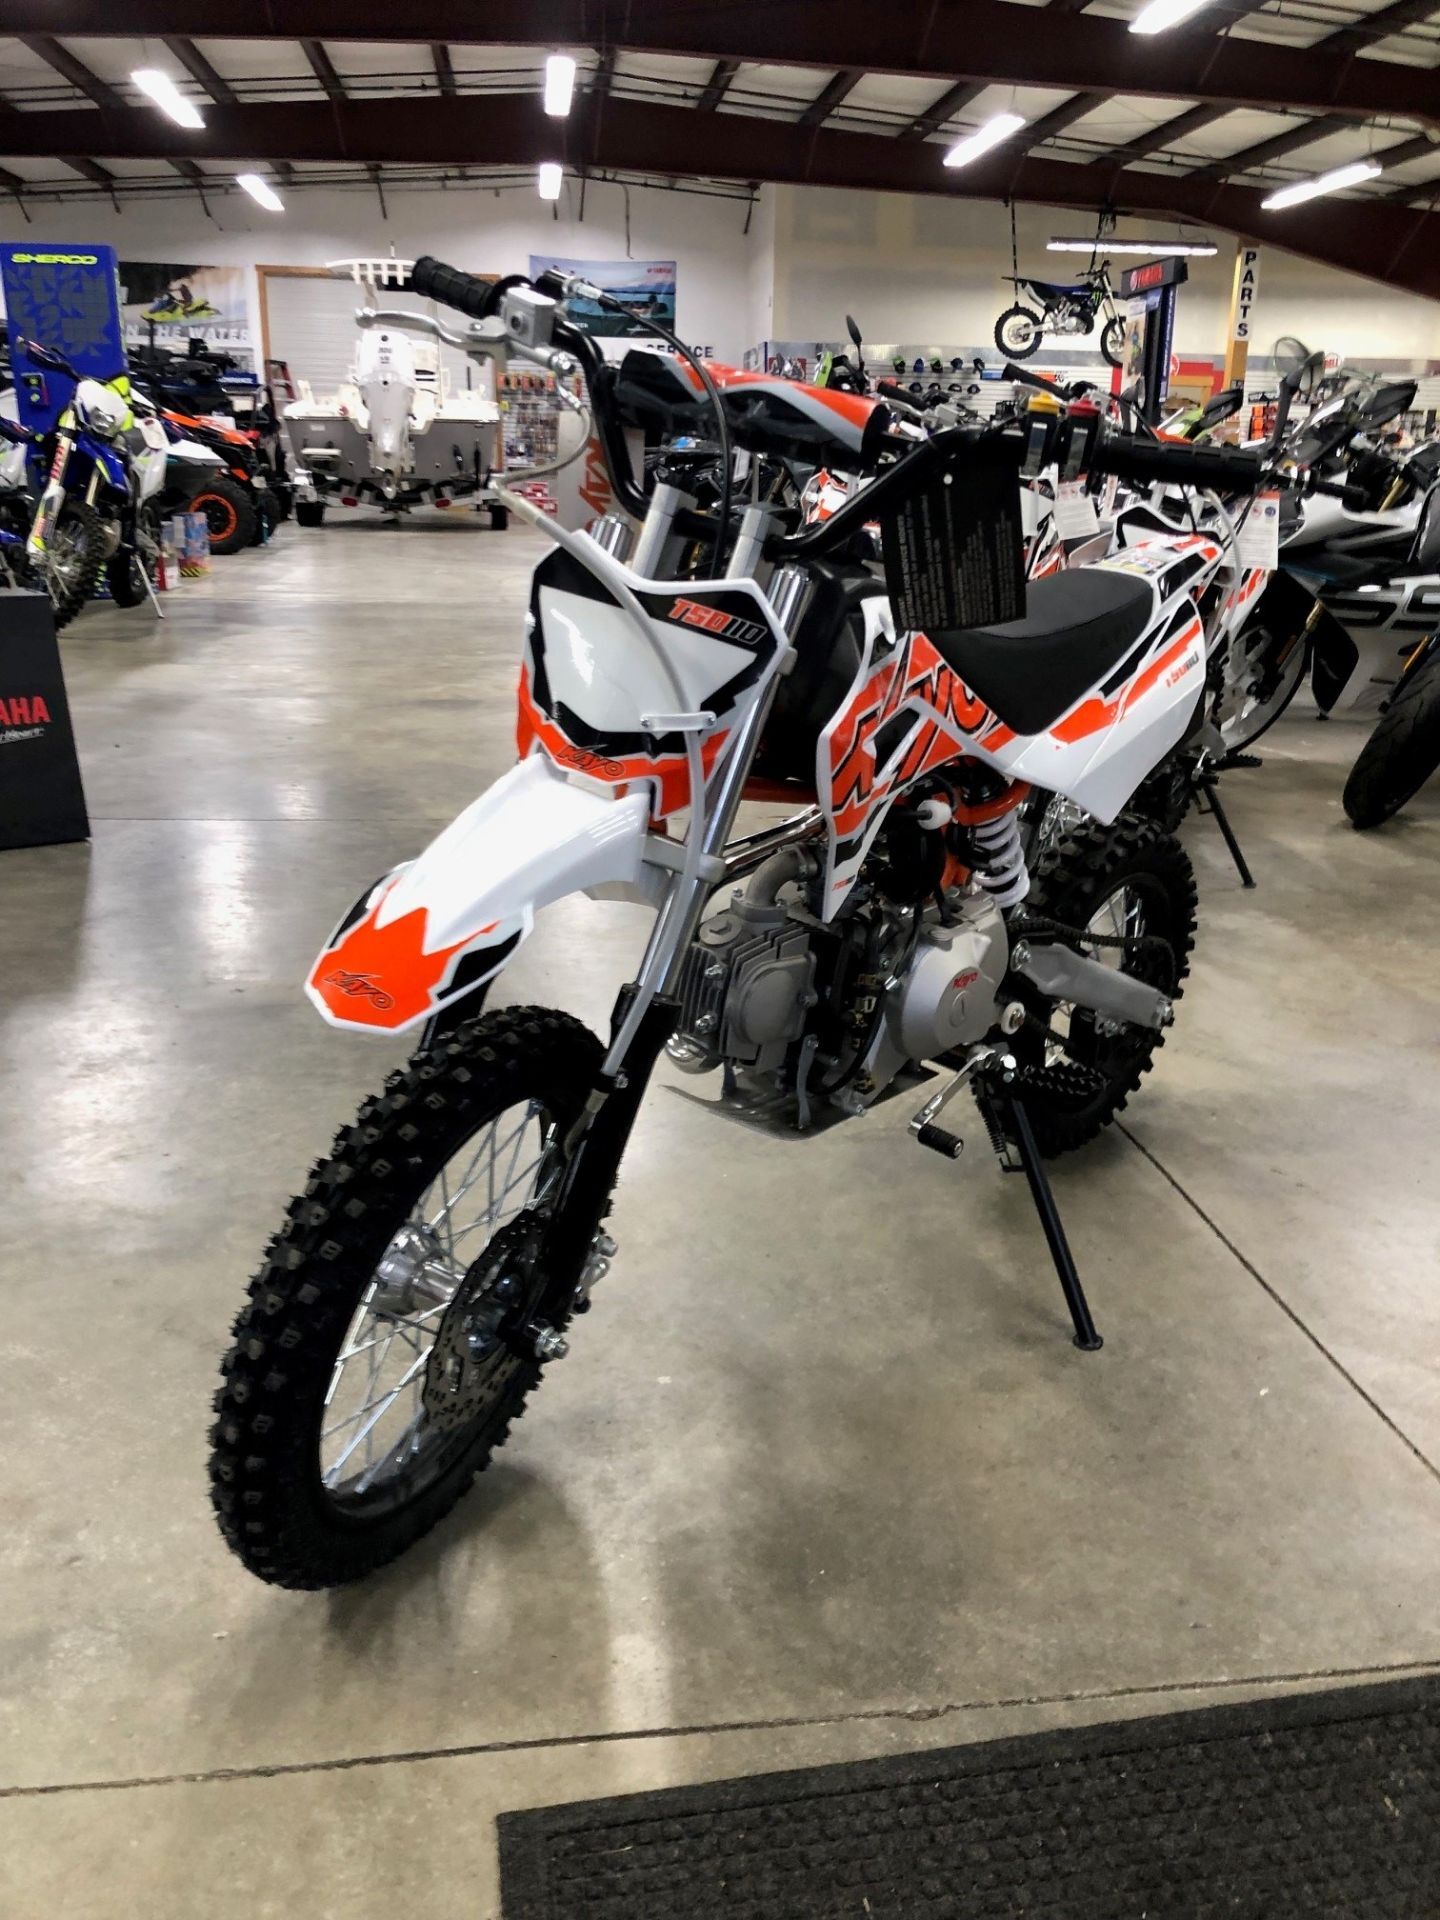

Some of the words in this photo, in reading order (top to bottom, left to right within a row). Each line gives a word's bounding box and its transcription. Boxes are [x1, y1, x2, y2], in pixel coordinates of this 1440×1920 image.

[11, 253, 98, 265] SHERCO
[1237, 251, 1257, 337] PARTS
[647, 344, 714, 358] ERCE
